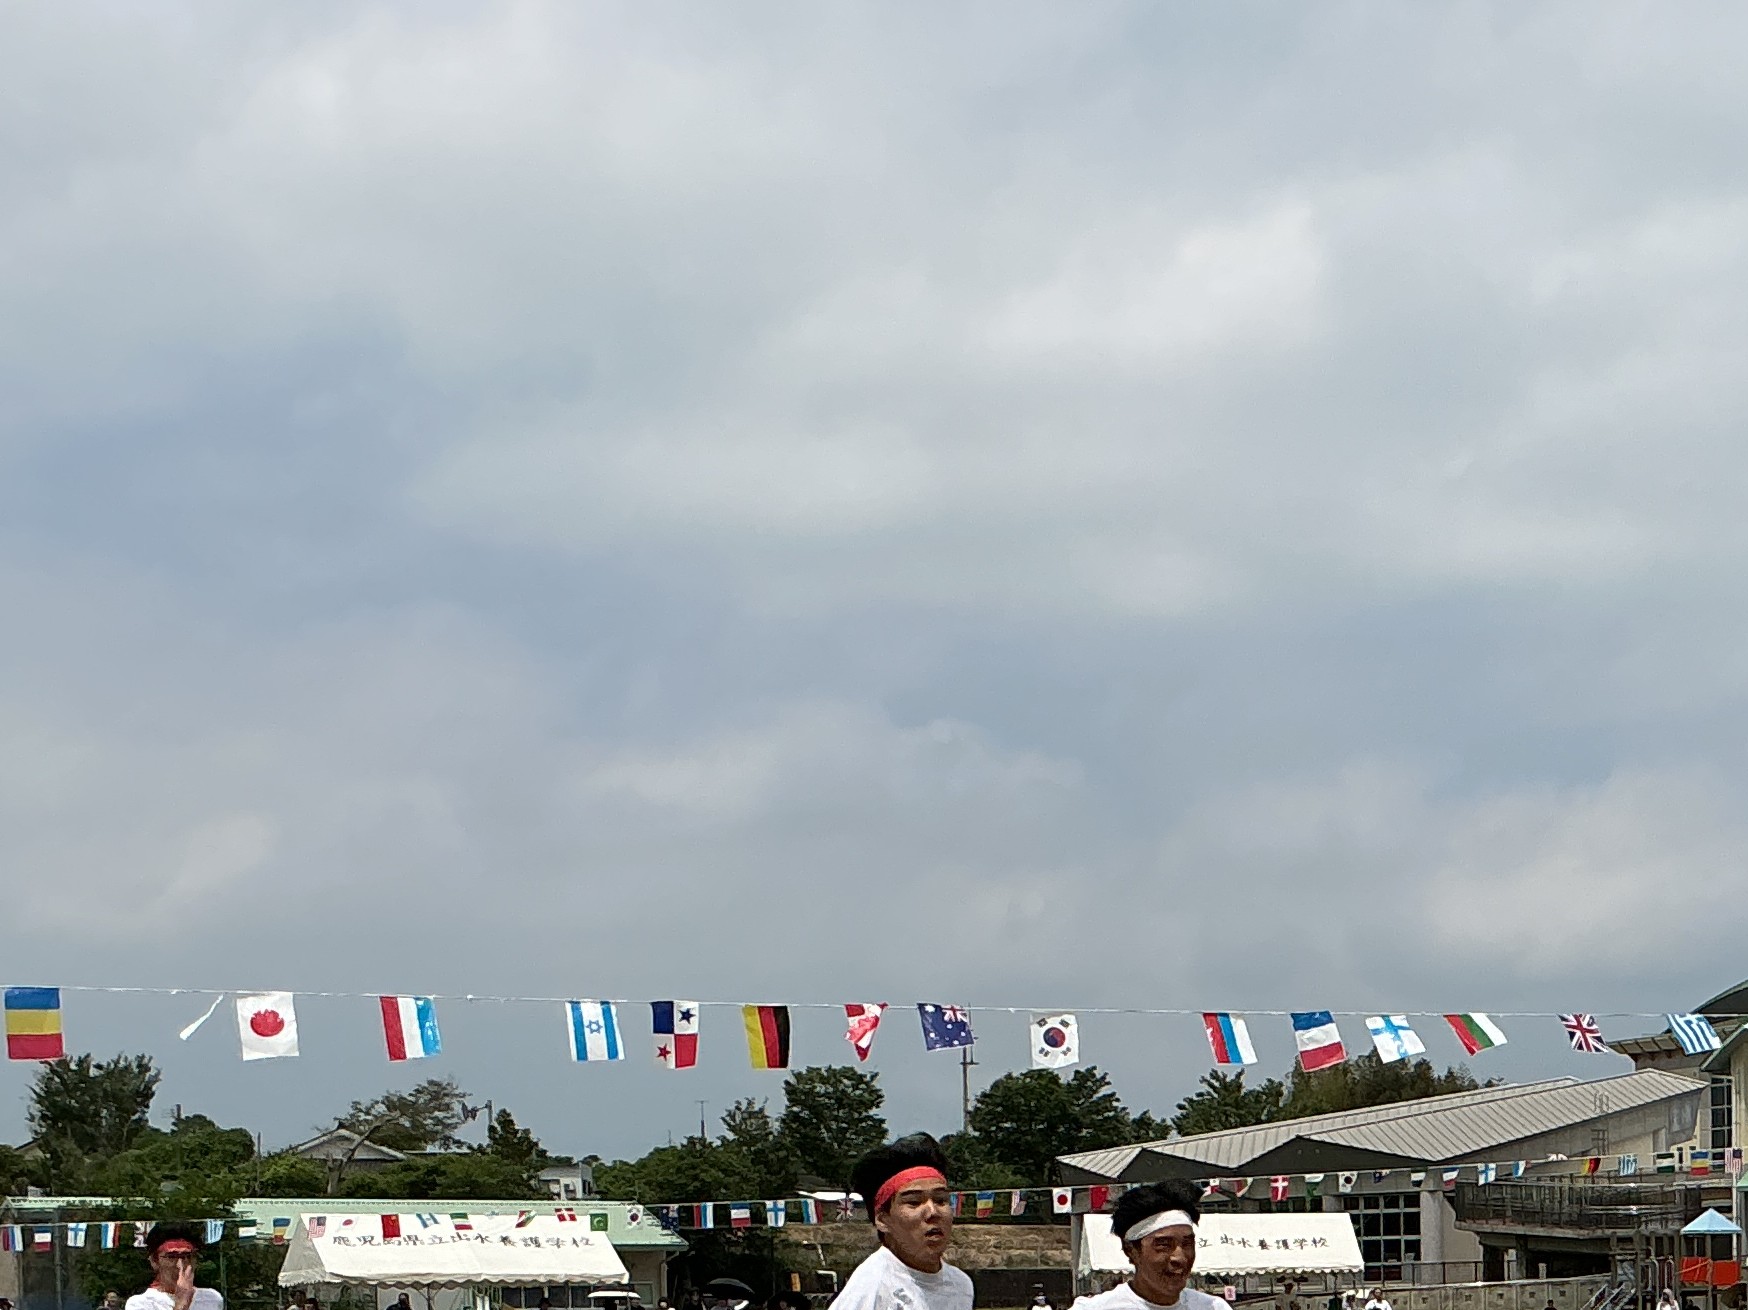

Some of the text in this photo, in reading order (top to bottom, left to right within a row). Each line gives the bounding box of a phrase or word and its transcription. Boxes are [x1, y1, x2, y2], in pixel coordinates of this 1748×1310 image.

[1197, 1234, 1331, 1250] 立出水養護学校
